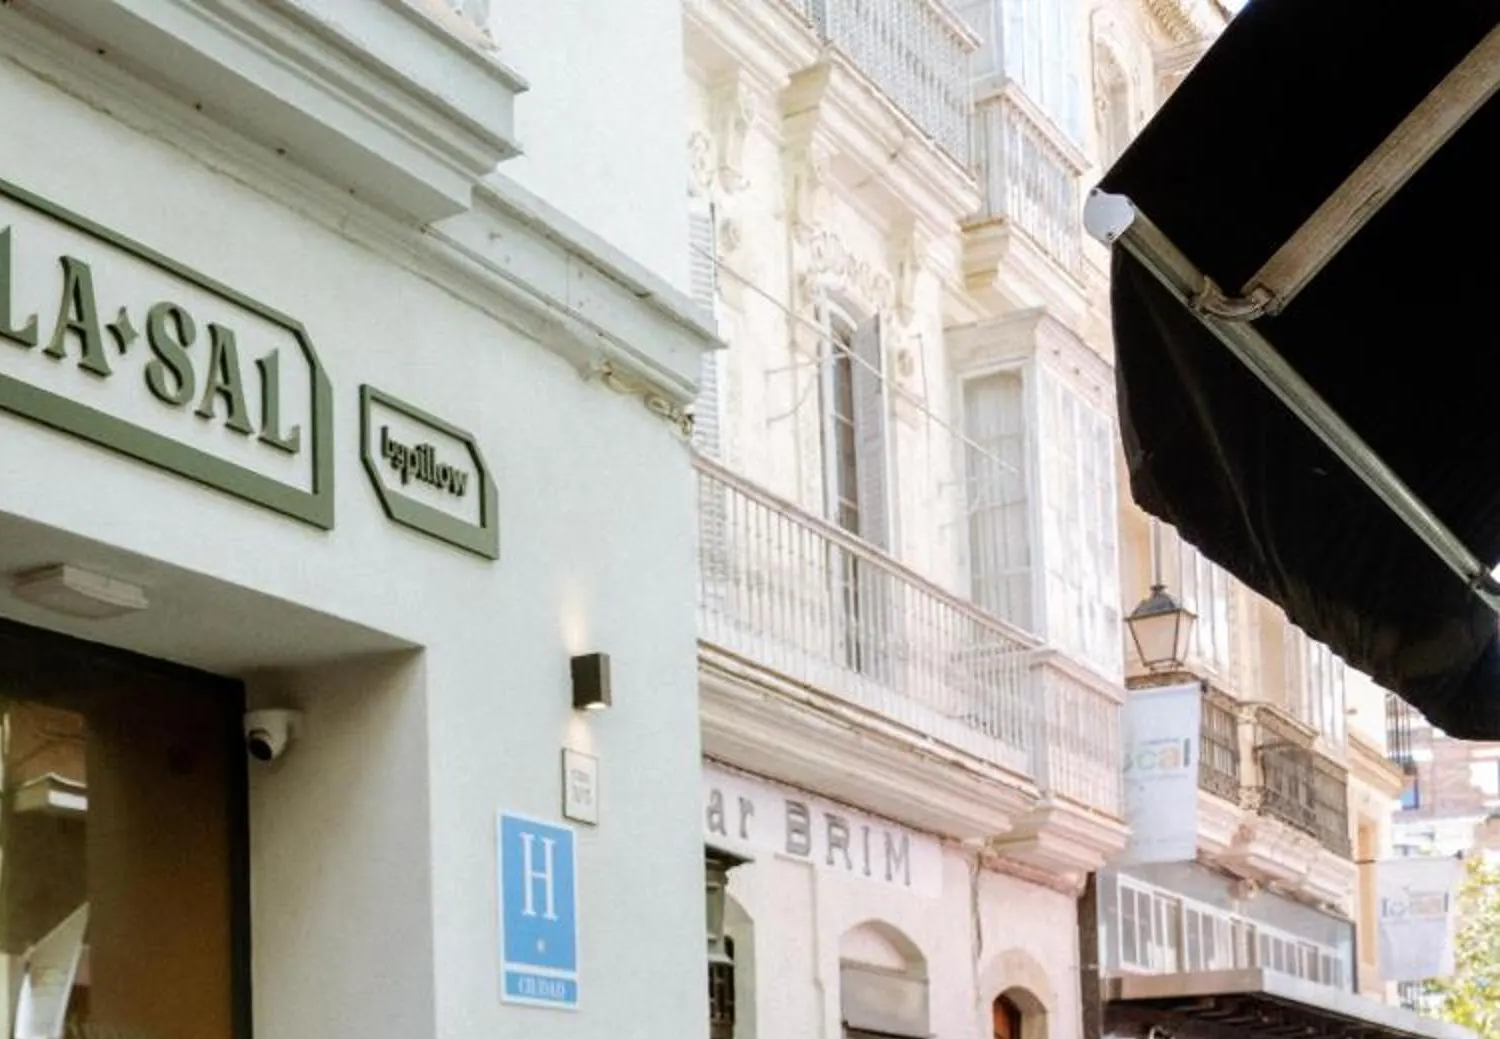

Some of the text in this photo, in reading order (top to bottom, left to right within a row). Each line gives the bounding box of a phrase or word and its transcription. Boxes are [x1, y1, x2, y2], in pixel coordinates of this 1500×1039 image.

[144, 301, 301, 454] SAL
[520, 832, 557, 922] H
[785, 800, 911, 886] BRIM
